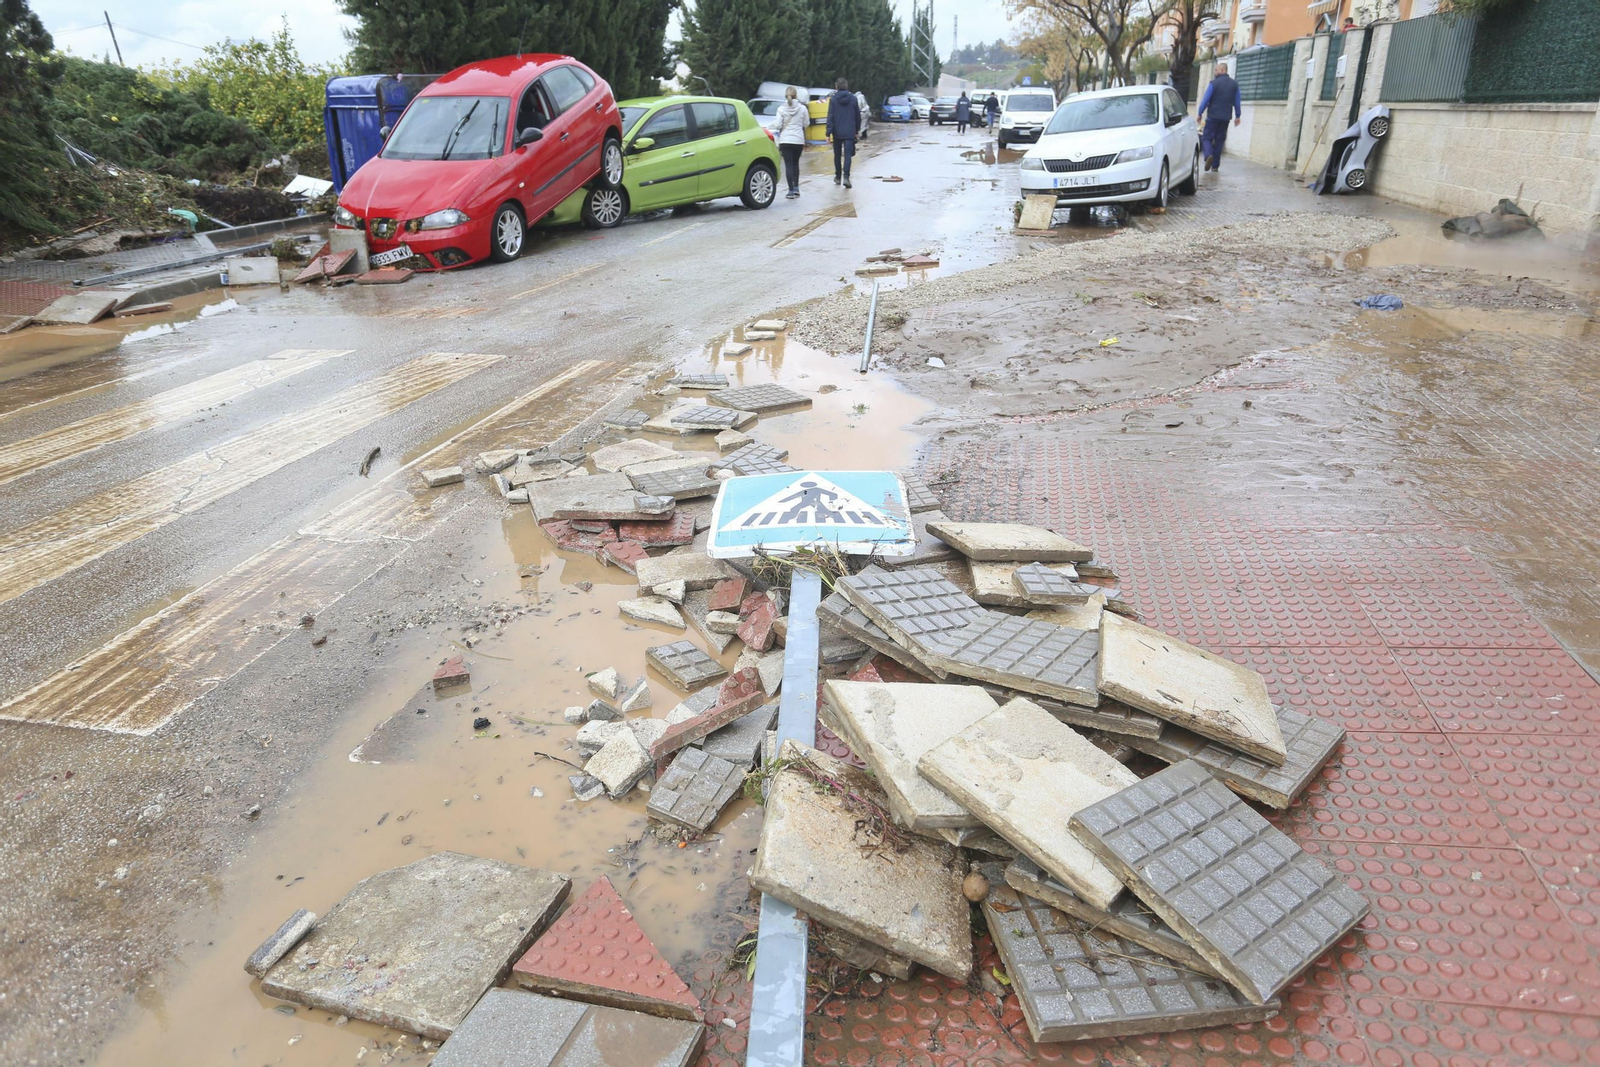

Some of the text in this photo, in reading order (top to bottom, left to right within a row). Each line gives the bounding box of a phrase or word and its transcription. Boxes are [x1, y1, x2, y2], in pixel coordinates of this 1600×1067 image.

[1059, 176, 1097, 187] 4714 JLT
[370, 253, 392, 266] 0933
